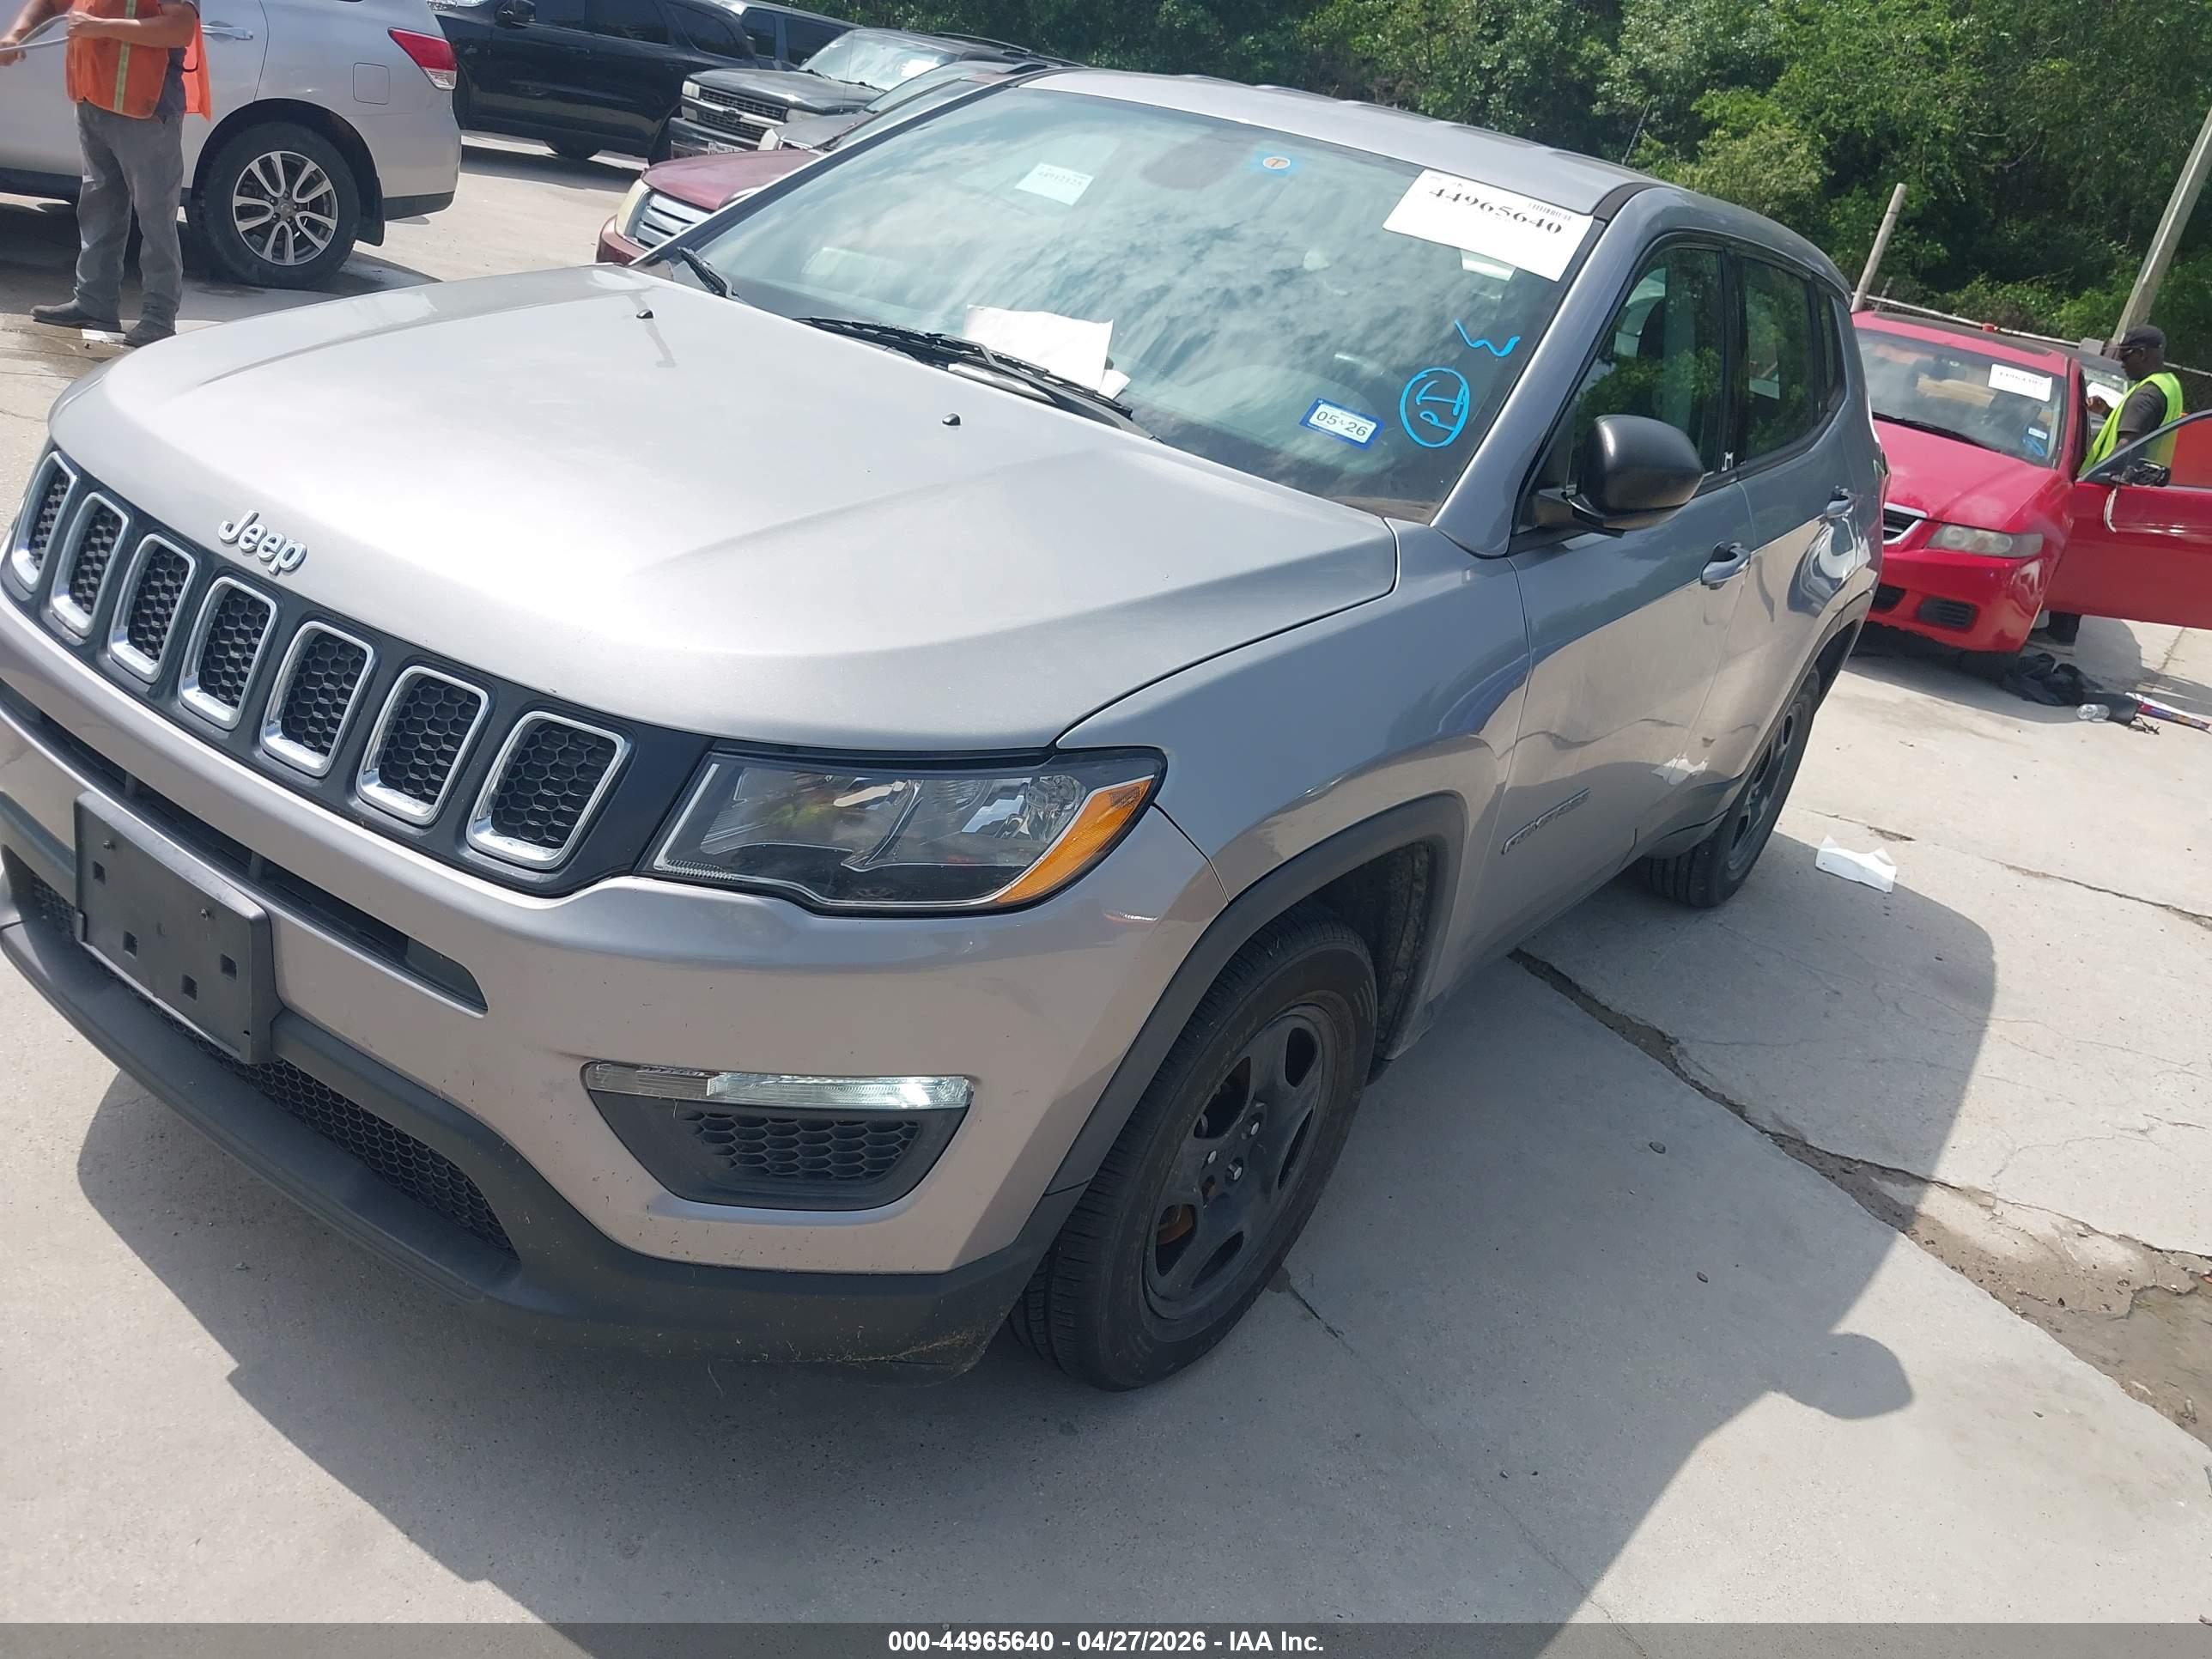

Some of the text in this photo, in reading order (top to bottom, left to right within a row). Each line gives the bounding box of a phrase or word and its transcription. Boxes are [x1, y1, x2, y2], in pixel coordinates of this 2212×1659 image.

[1428, 187, 1563, 235] 44965640
[1316, 410, 1340, 426] 05
[1345, 422, 1369, 437] 26
[218, 509, 307, 576] Jeep
